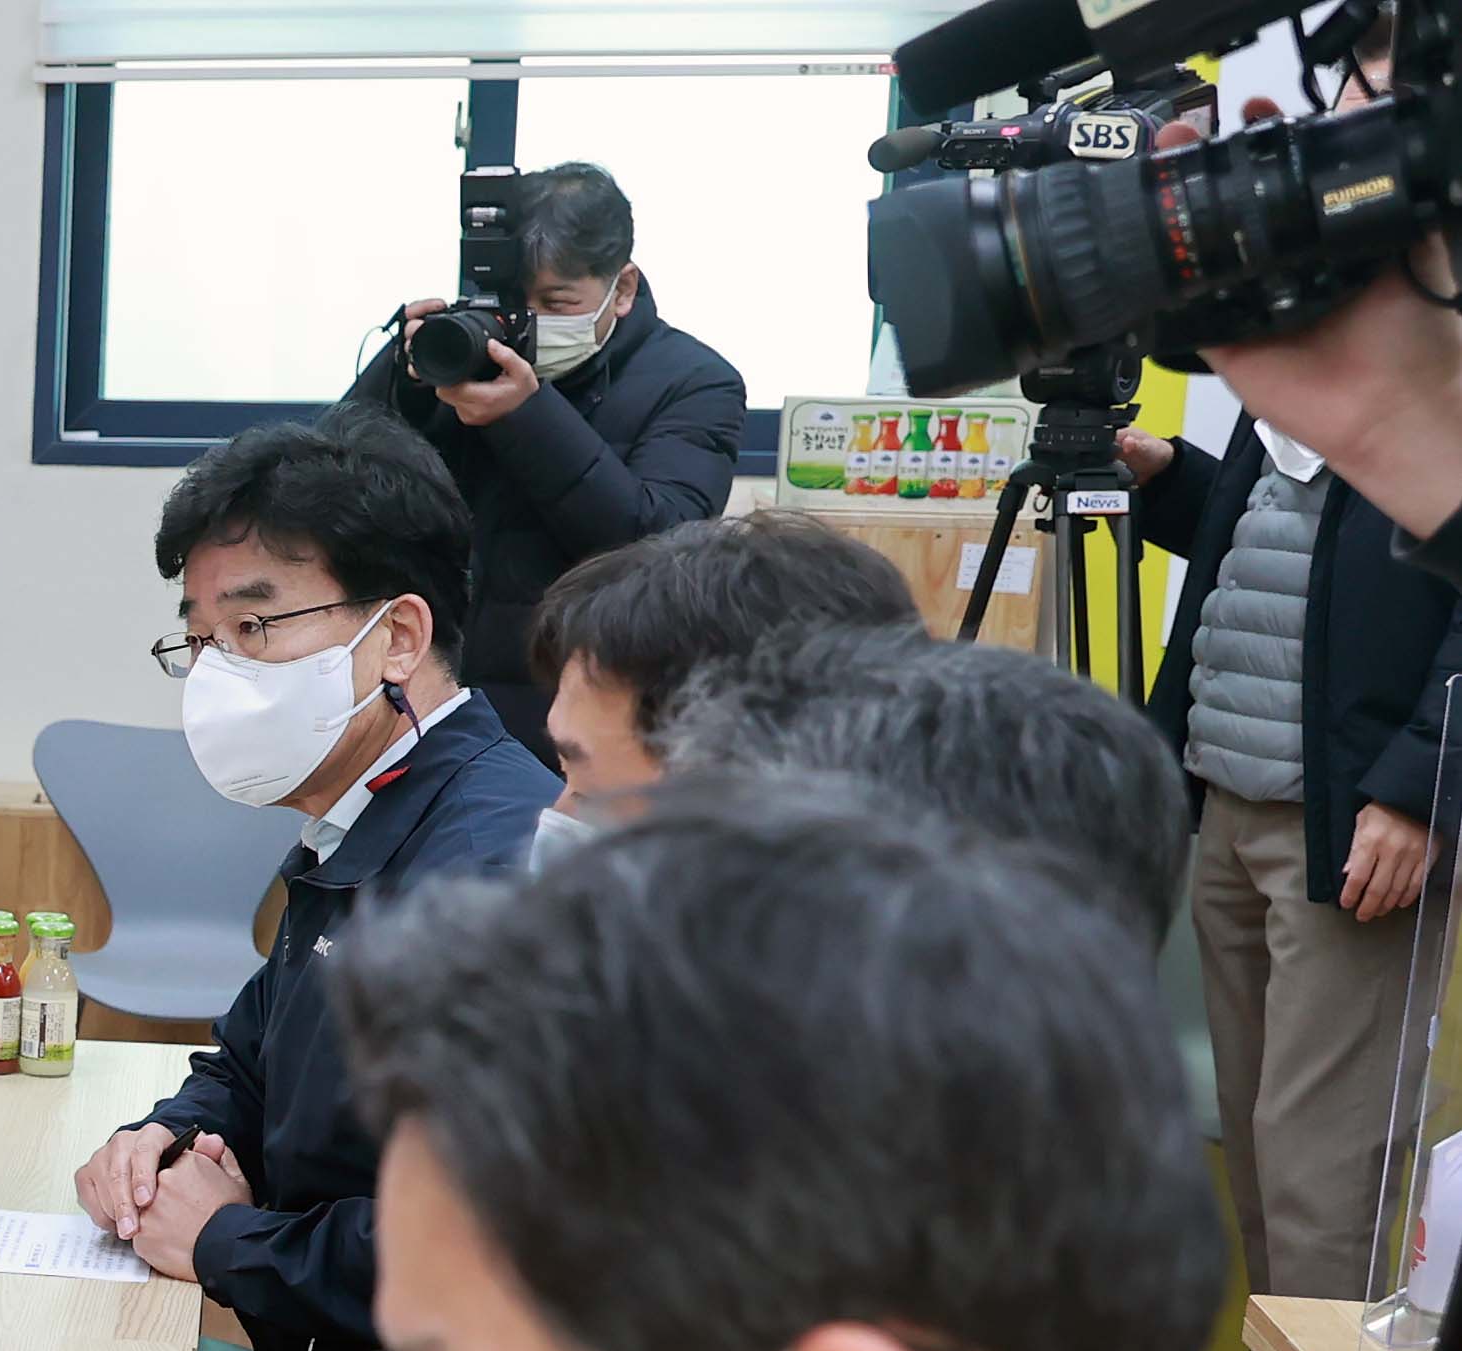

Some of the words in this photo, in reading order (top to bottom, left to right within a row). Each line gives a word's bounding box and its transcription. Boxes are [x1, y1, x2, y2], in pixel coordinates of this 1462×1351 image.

[1074, 123, 1132, 149] SBS
[1322, 175, 1395, 208] FUJINON
[1077, 496, 1121, 509] News
